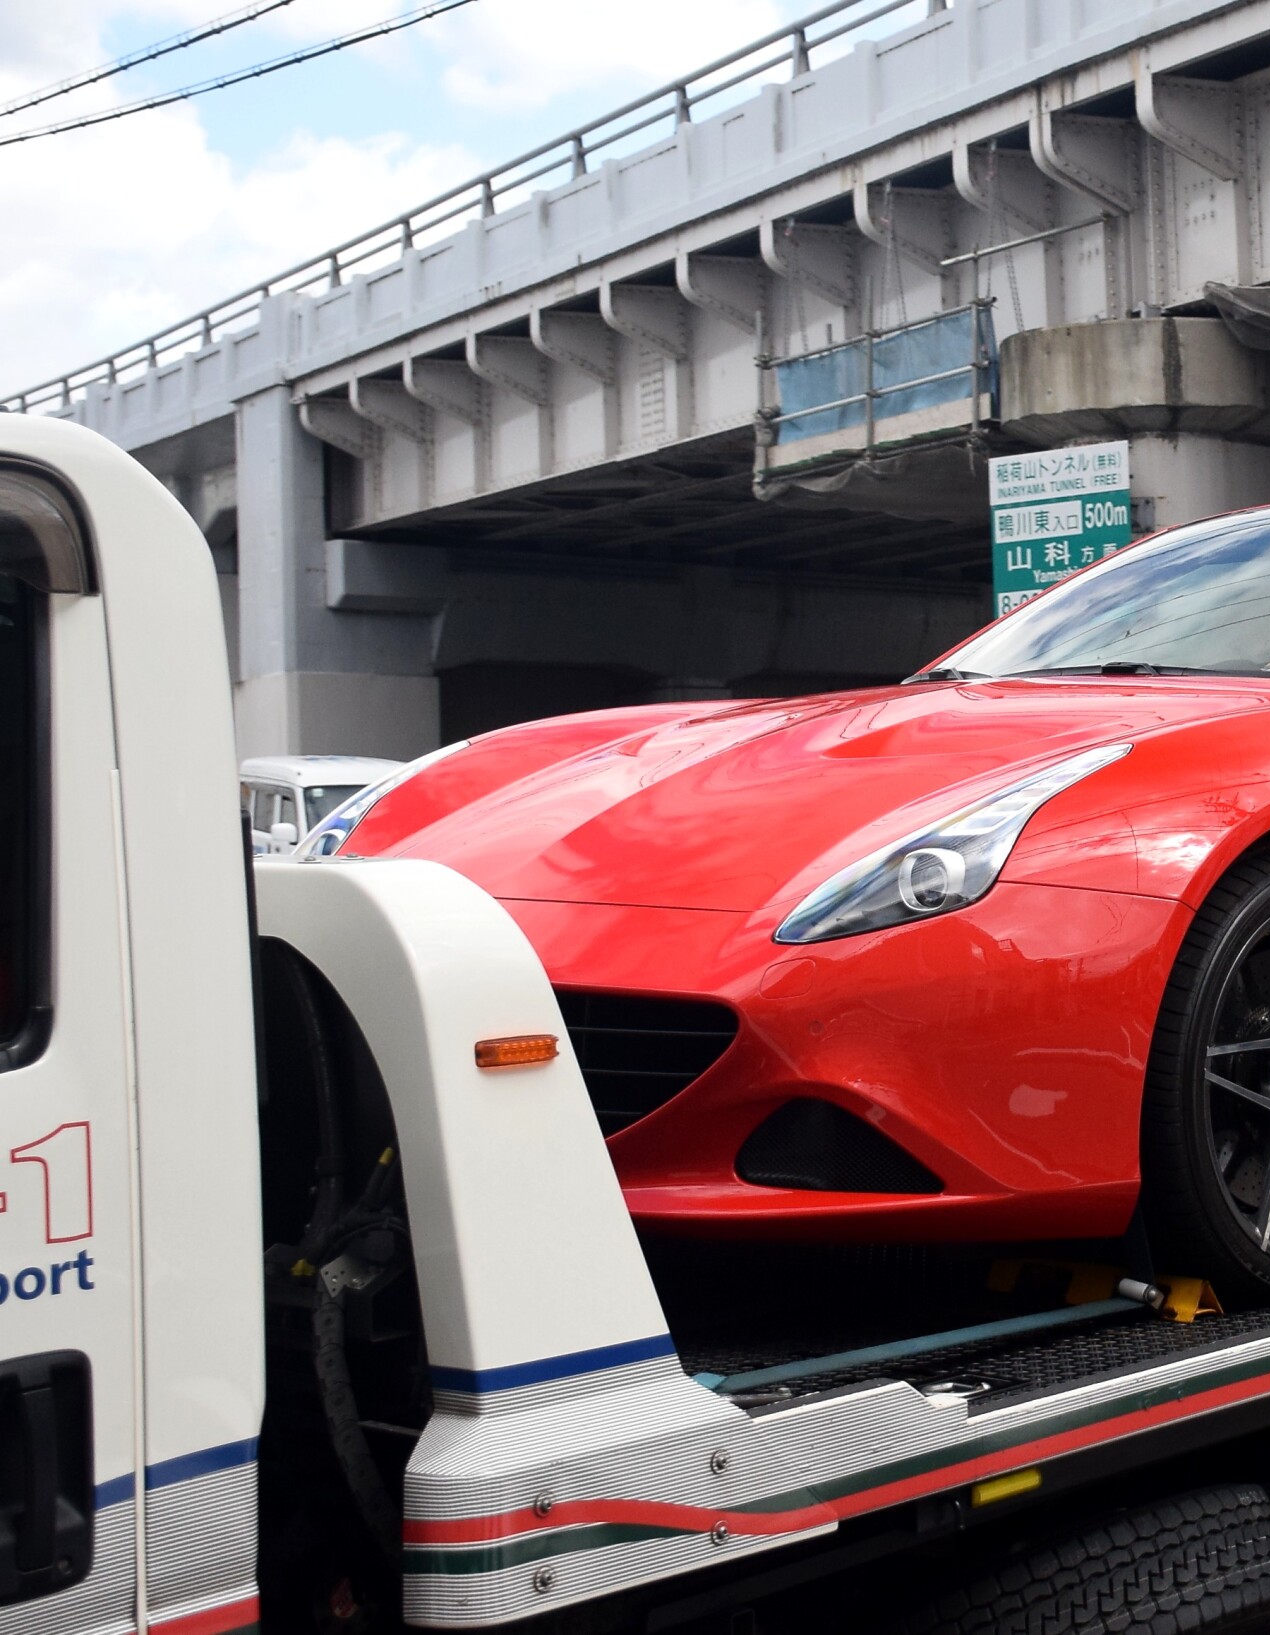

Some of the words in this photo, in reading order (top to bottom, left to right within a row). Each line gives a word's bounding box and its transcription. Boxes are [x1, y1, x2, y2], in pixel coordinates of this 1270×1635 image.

[997, 482, 1046, 499] INARIYAMA
[1050, 477, 1086, 492] TUNNEL
[1085, 501, 1128, 529] 500m
